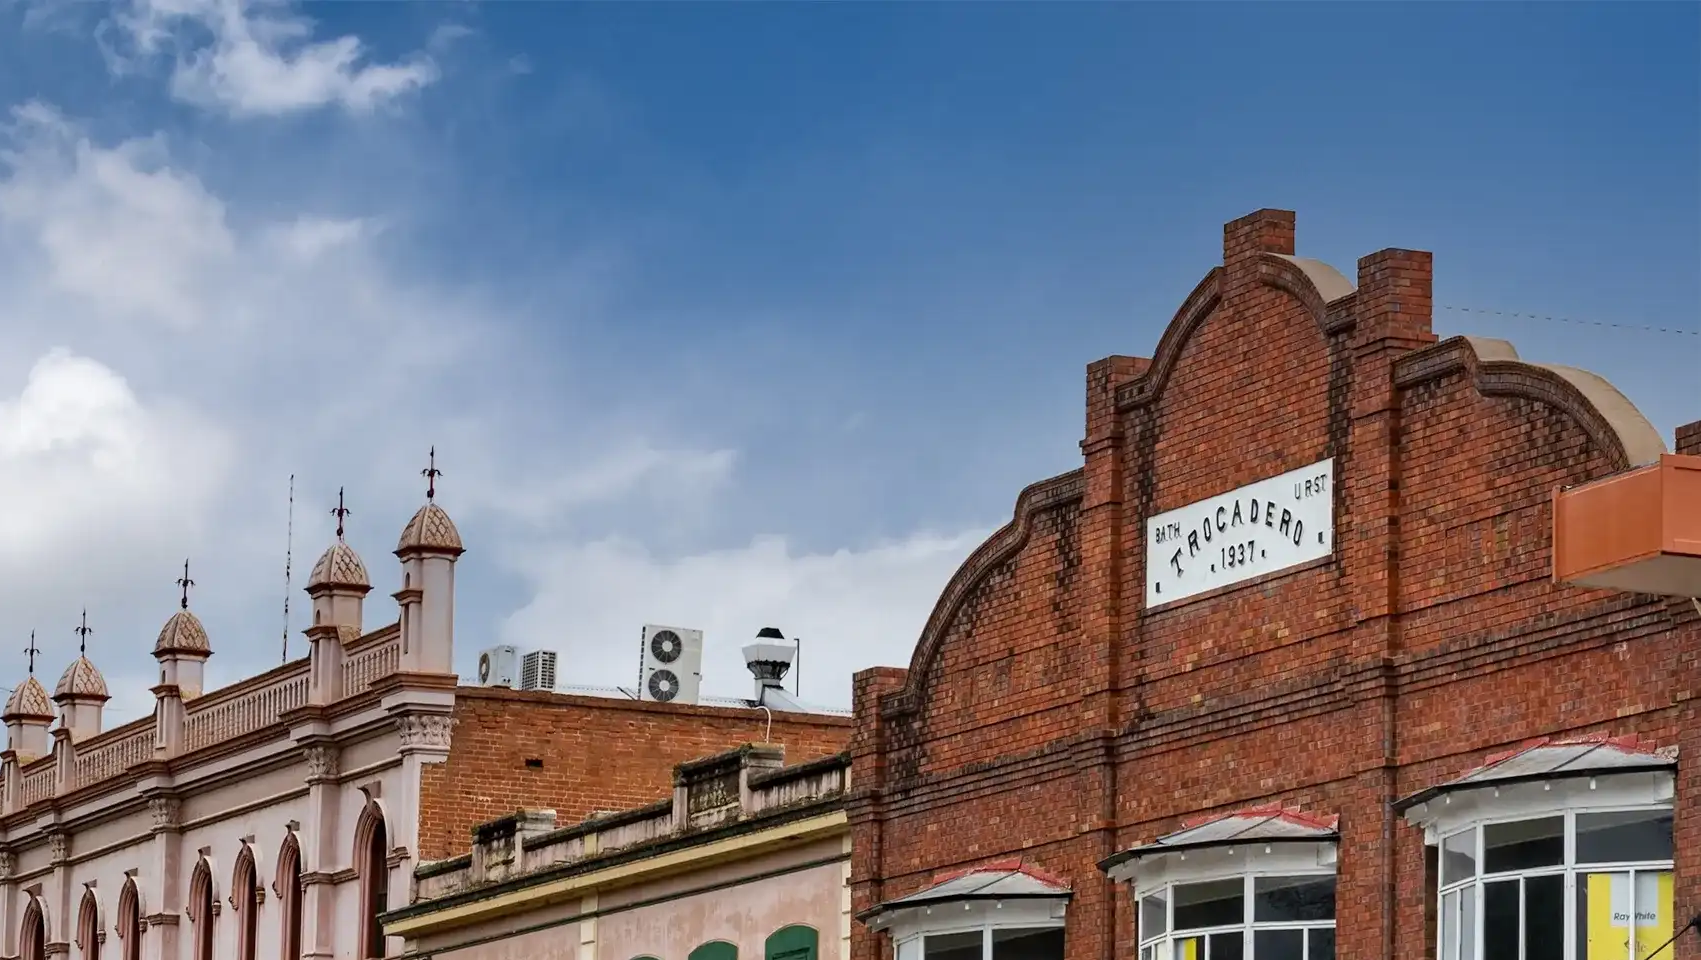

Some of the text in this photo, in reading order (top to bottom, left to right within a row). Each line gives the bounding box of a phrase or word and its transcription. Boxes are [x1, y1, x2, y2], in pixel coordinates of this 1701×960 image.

[1156, 474, 1327, 544] BATH URST
[1170, 498, 1303, 578] TROCADERO
[1221, 540, 1255, 570] 1937
